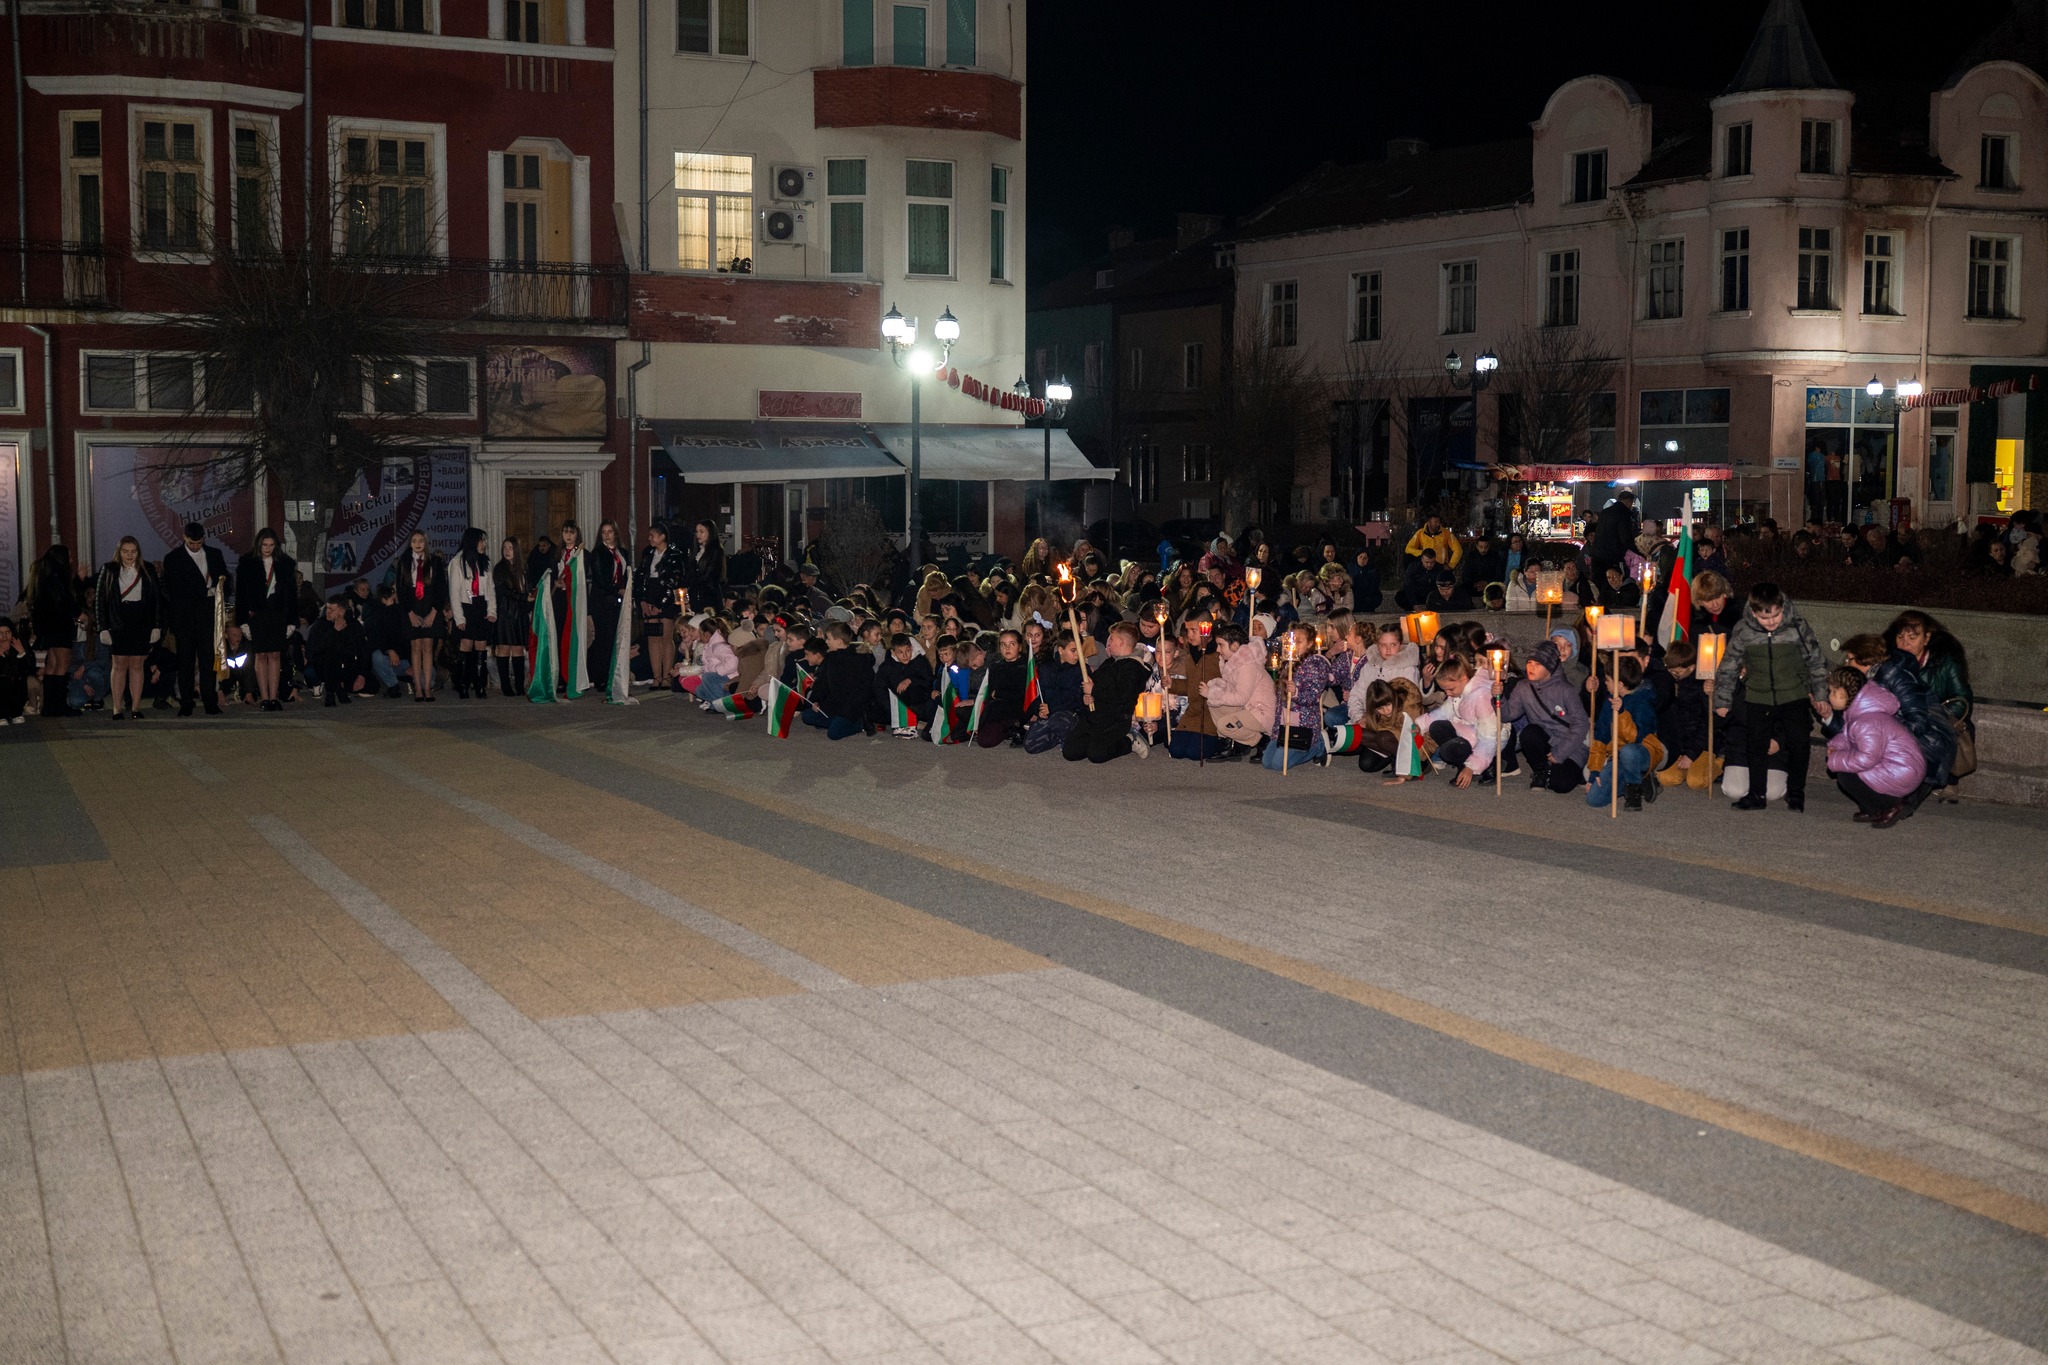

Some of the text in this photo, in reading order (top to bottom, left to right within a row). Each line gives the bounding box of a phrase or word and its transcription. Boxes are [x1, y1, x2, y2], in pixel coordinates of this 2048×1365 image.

[441, 467, 465, 475] ВАЗИ
[438, 481, 465, 489] ЧАШИ
[342, 493, 392, 520] Ниски
[434, 496, 466, 504] ЧИНИИ
[179, 500, 232, 528] Ниски
[436, 510, 466, 520] ДРЕХИ
[204, 517, 233, 539] ни!
[349, 509, 395, 536] цени!
[430, 525, 466, 533] ЧОРАПИ
[371, 515, 418, 566] ДОМАШНИ
